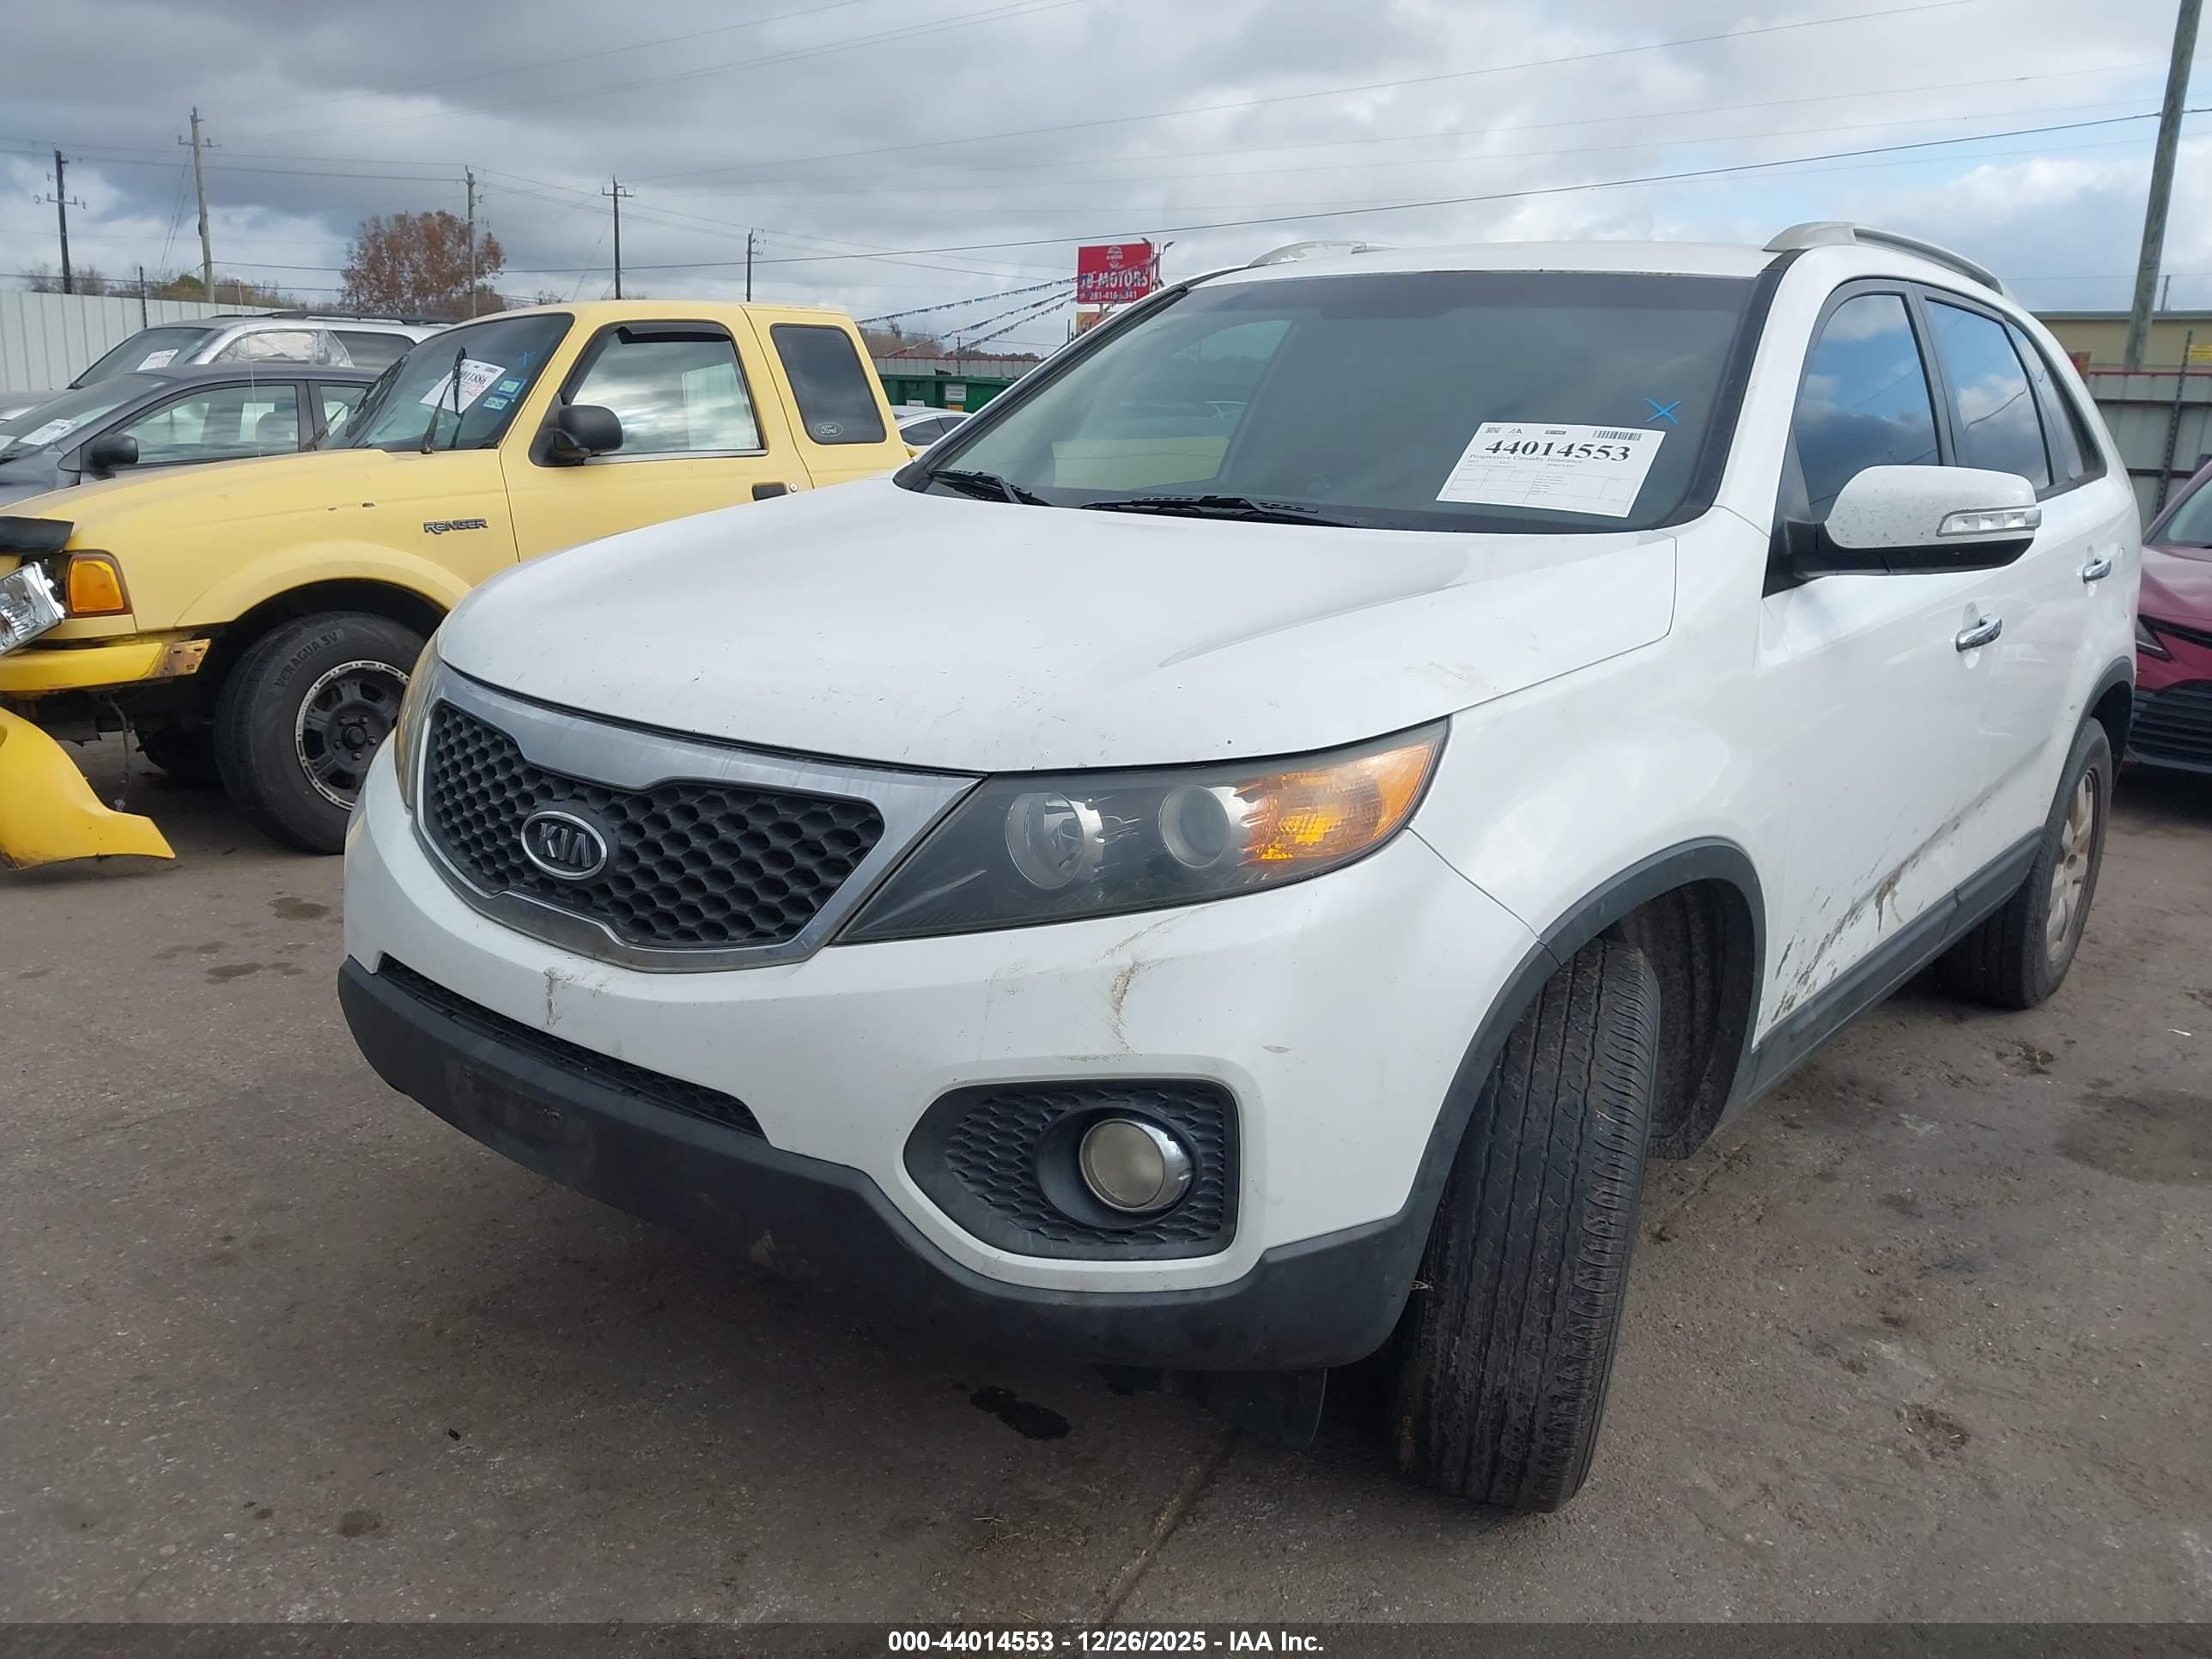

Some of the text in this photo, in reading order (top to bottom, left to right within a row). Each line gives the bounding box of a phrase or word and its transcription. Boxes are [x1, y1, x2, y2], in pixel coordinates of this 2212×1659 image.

[1099, 270, 1148, 288] MOTORS
[1485, 440, 1631, 462] 44014553
[275, 641, 321, 687] VERAGUA
[538, 822, 592, 868] KIA
